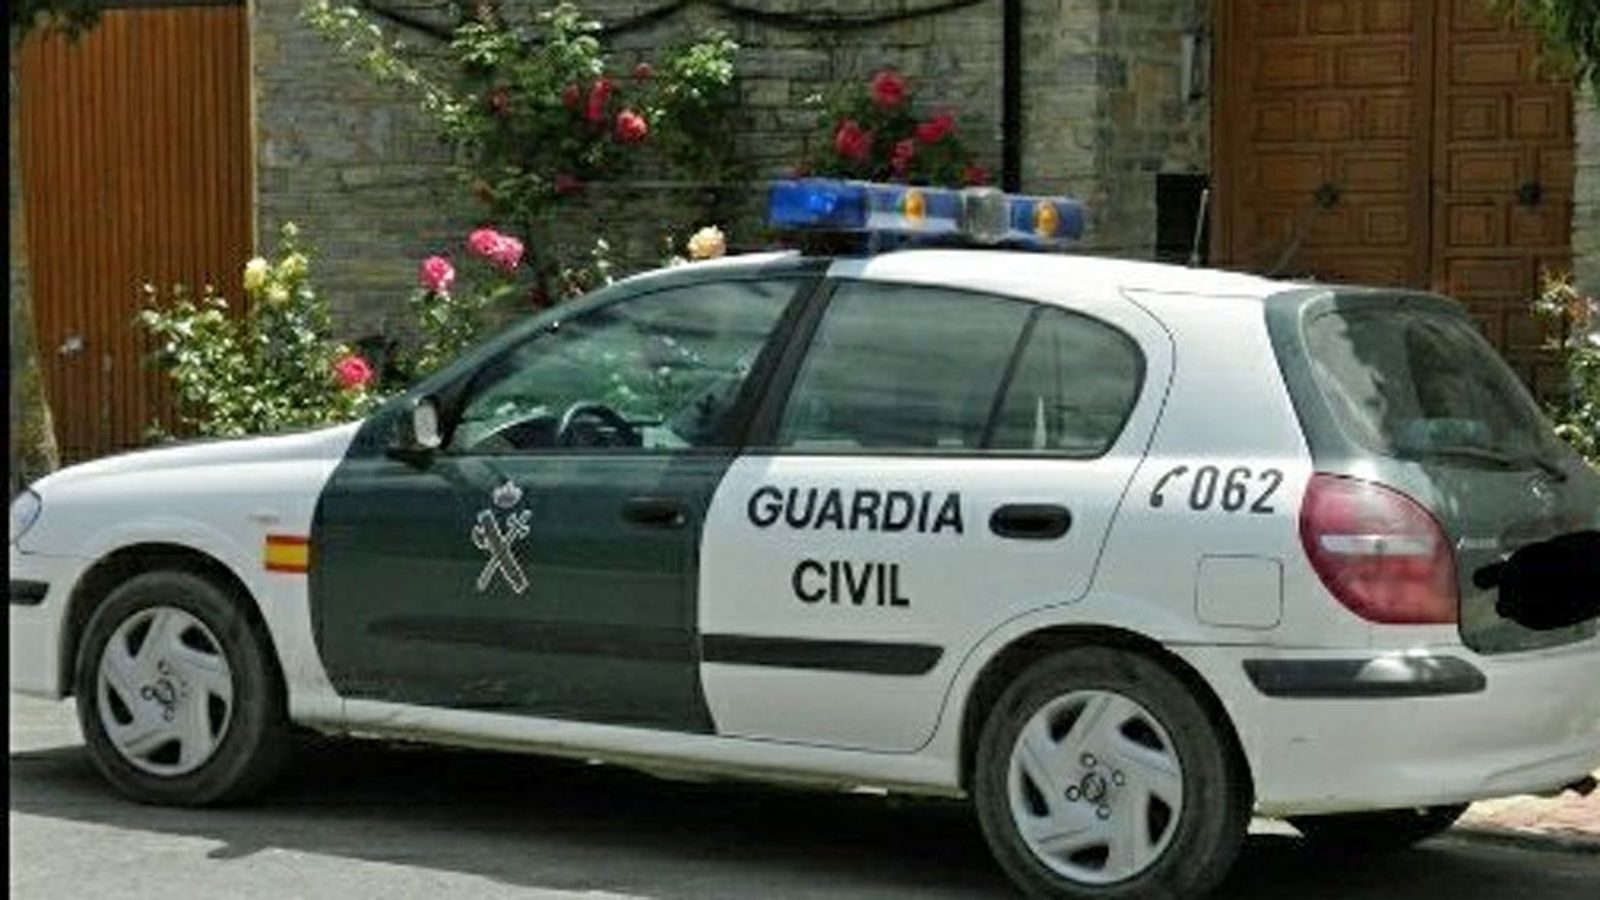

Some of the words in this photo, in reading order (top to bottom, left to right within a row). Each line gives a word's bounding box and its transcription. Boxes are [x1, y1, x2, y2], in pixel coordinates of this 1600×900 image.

[748, 486, 964, 534] GUARDIA
[1189, 465, 1284, 514] 062
[792, 559, 910, 607] CIVIL
